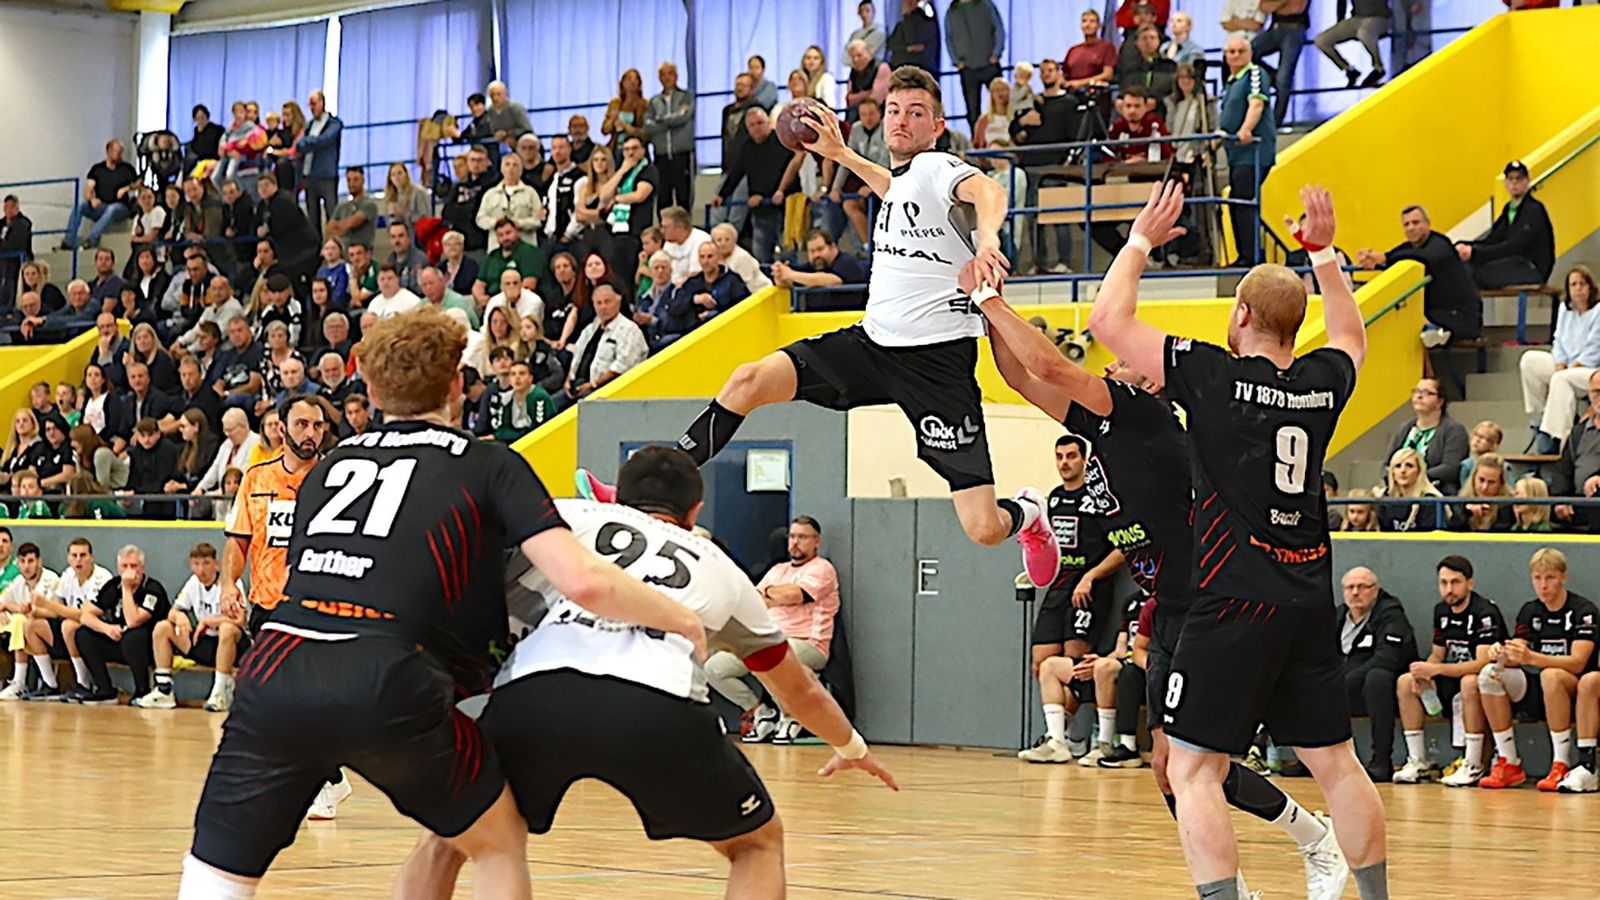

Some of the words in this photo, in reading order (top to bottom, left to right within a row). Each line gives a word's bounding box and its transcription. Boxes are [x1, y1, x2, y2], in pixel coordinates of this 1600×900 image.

[900, 227, 946, 239] PIEPER
[1235, 381, 1254, 402] TV
[1256, 385, 1285, 408] 1878
[1274, 425, 1309, 494] 9
[306, 458, 418, 538] 21
[595, 521, 702, 589] 95
[918, 559, 940, 595] E
